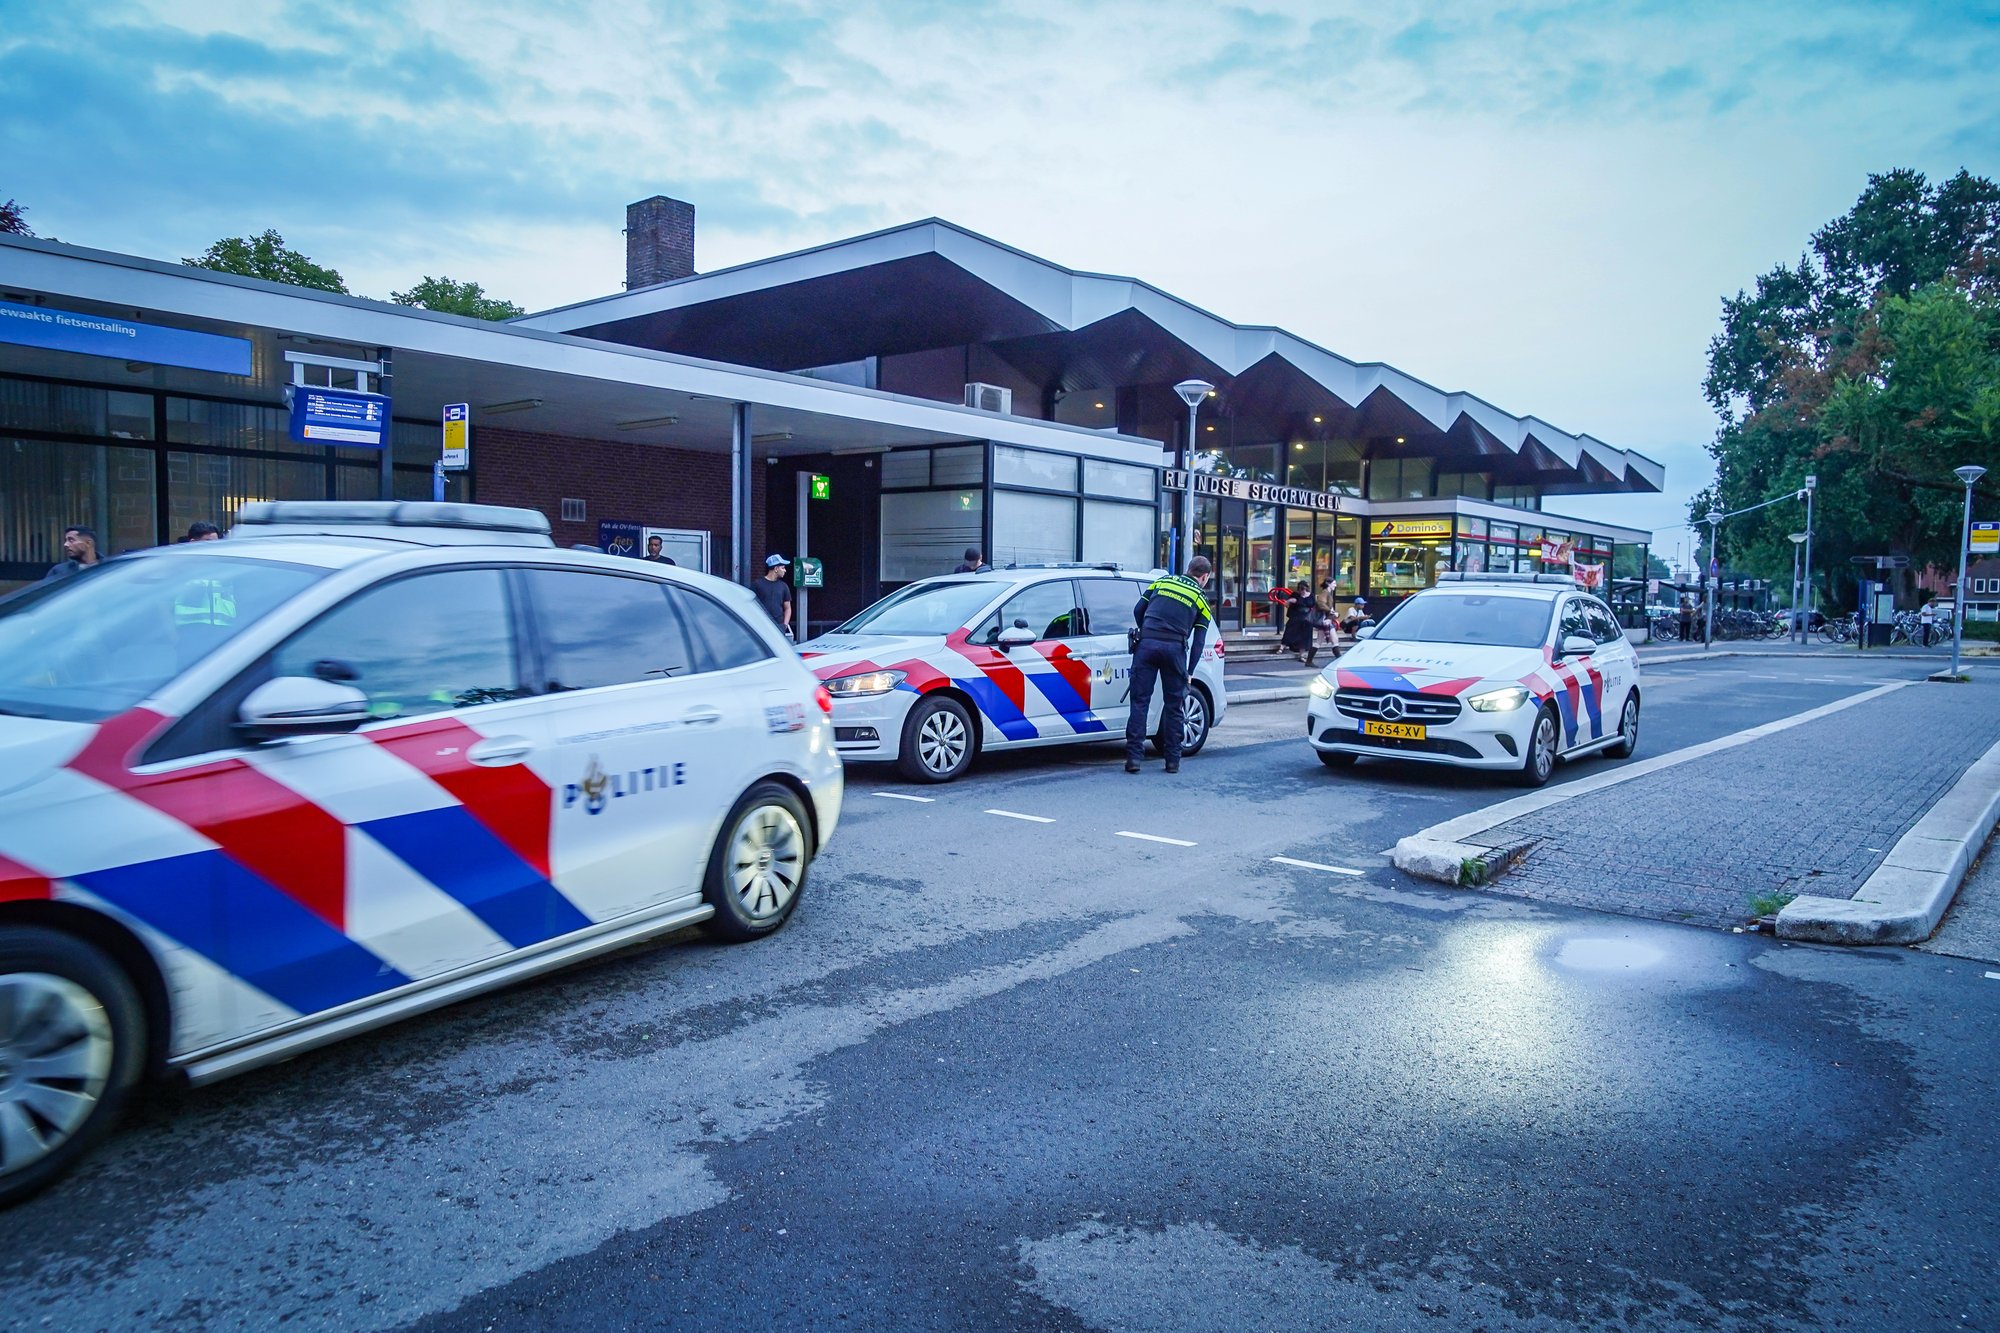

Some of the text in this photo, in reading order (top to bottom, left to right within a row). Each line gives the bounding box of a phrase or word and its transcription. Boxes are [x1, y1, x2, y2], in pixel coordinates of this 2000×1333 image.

[56, 314, 136, 337] fietsenstalling
[1165, 469, 1342, 510] RLNDSE SPOORWEGEN
[1397, 523, 1444, 533] Domino's
[1379, 657, 1454, 666] POLITIE
[1367, 722, 1420, 737] T-654-XV
[563, 761, 687, 816] POLITIE
